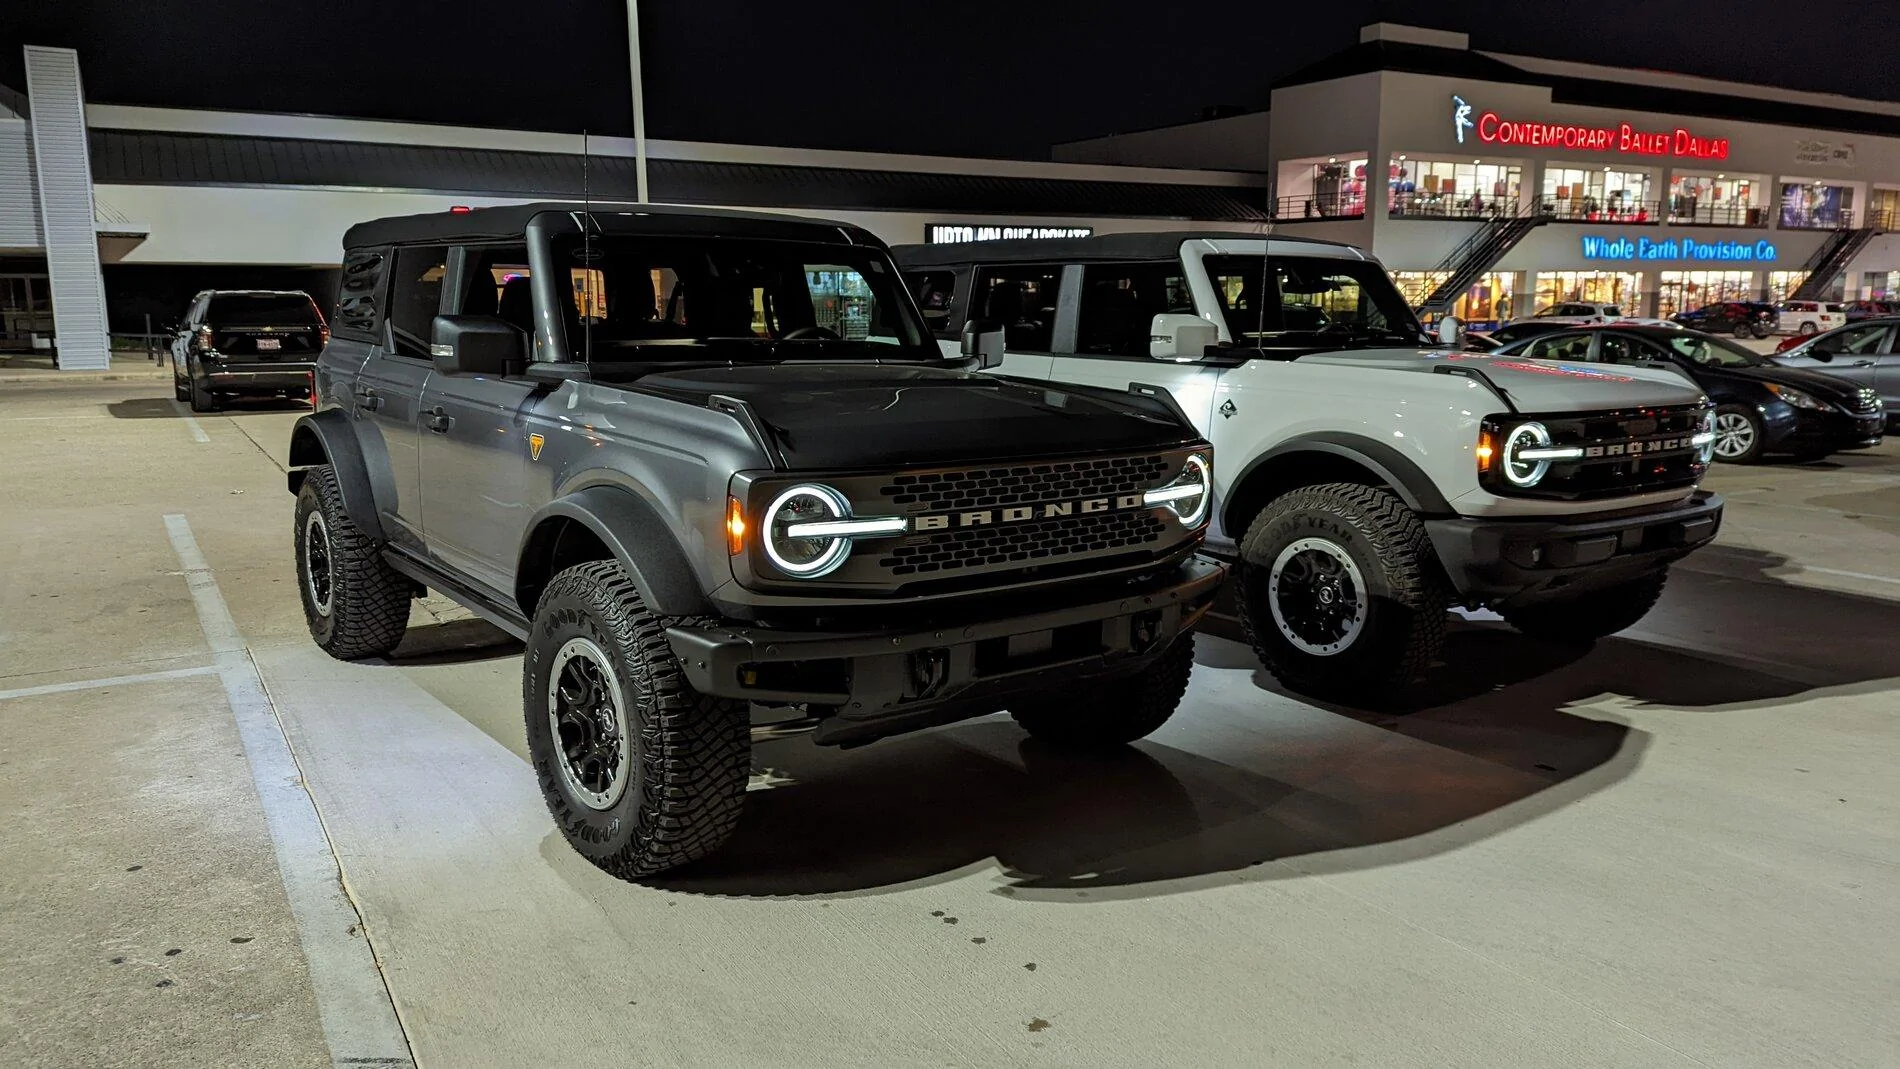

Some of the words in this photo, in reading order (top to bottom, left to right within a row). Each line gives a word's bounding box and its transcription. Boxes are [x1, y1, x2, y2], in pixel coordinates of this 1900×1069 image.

[1478, 112, 1615, 150] CONTEMPORARY
[1619, 123, 1670, 154] BALLET
[1674, 128, 1728, 159] DALLAS
[1583, 236, 1634, 260] Whole
[1639, 237, 1678, 260] Earth
[1682, 238, 1752, 261] Provision
[1755, 239, 1776, 261] Co.
[1586, 437, 1693, 458] BRONCO
[914, 493, 1143, 532] BRONCO
